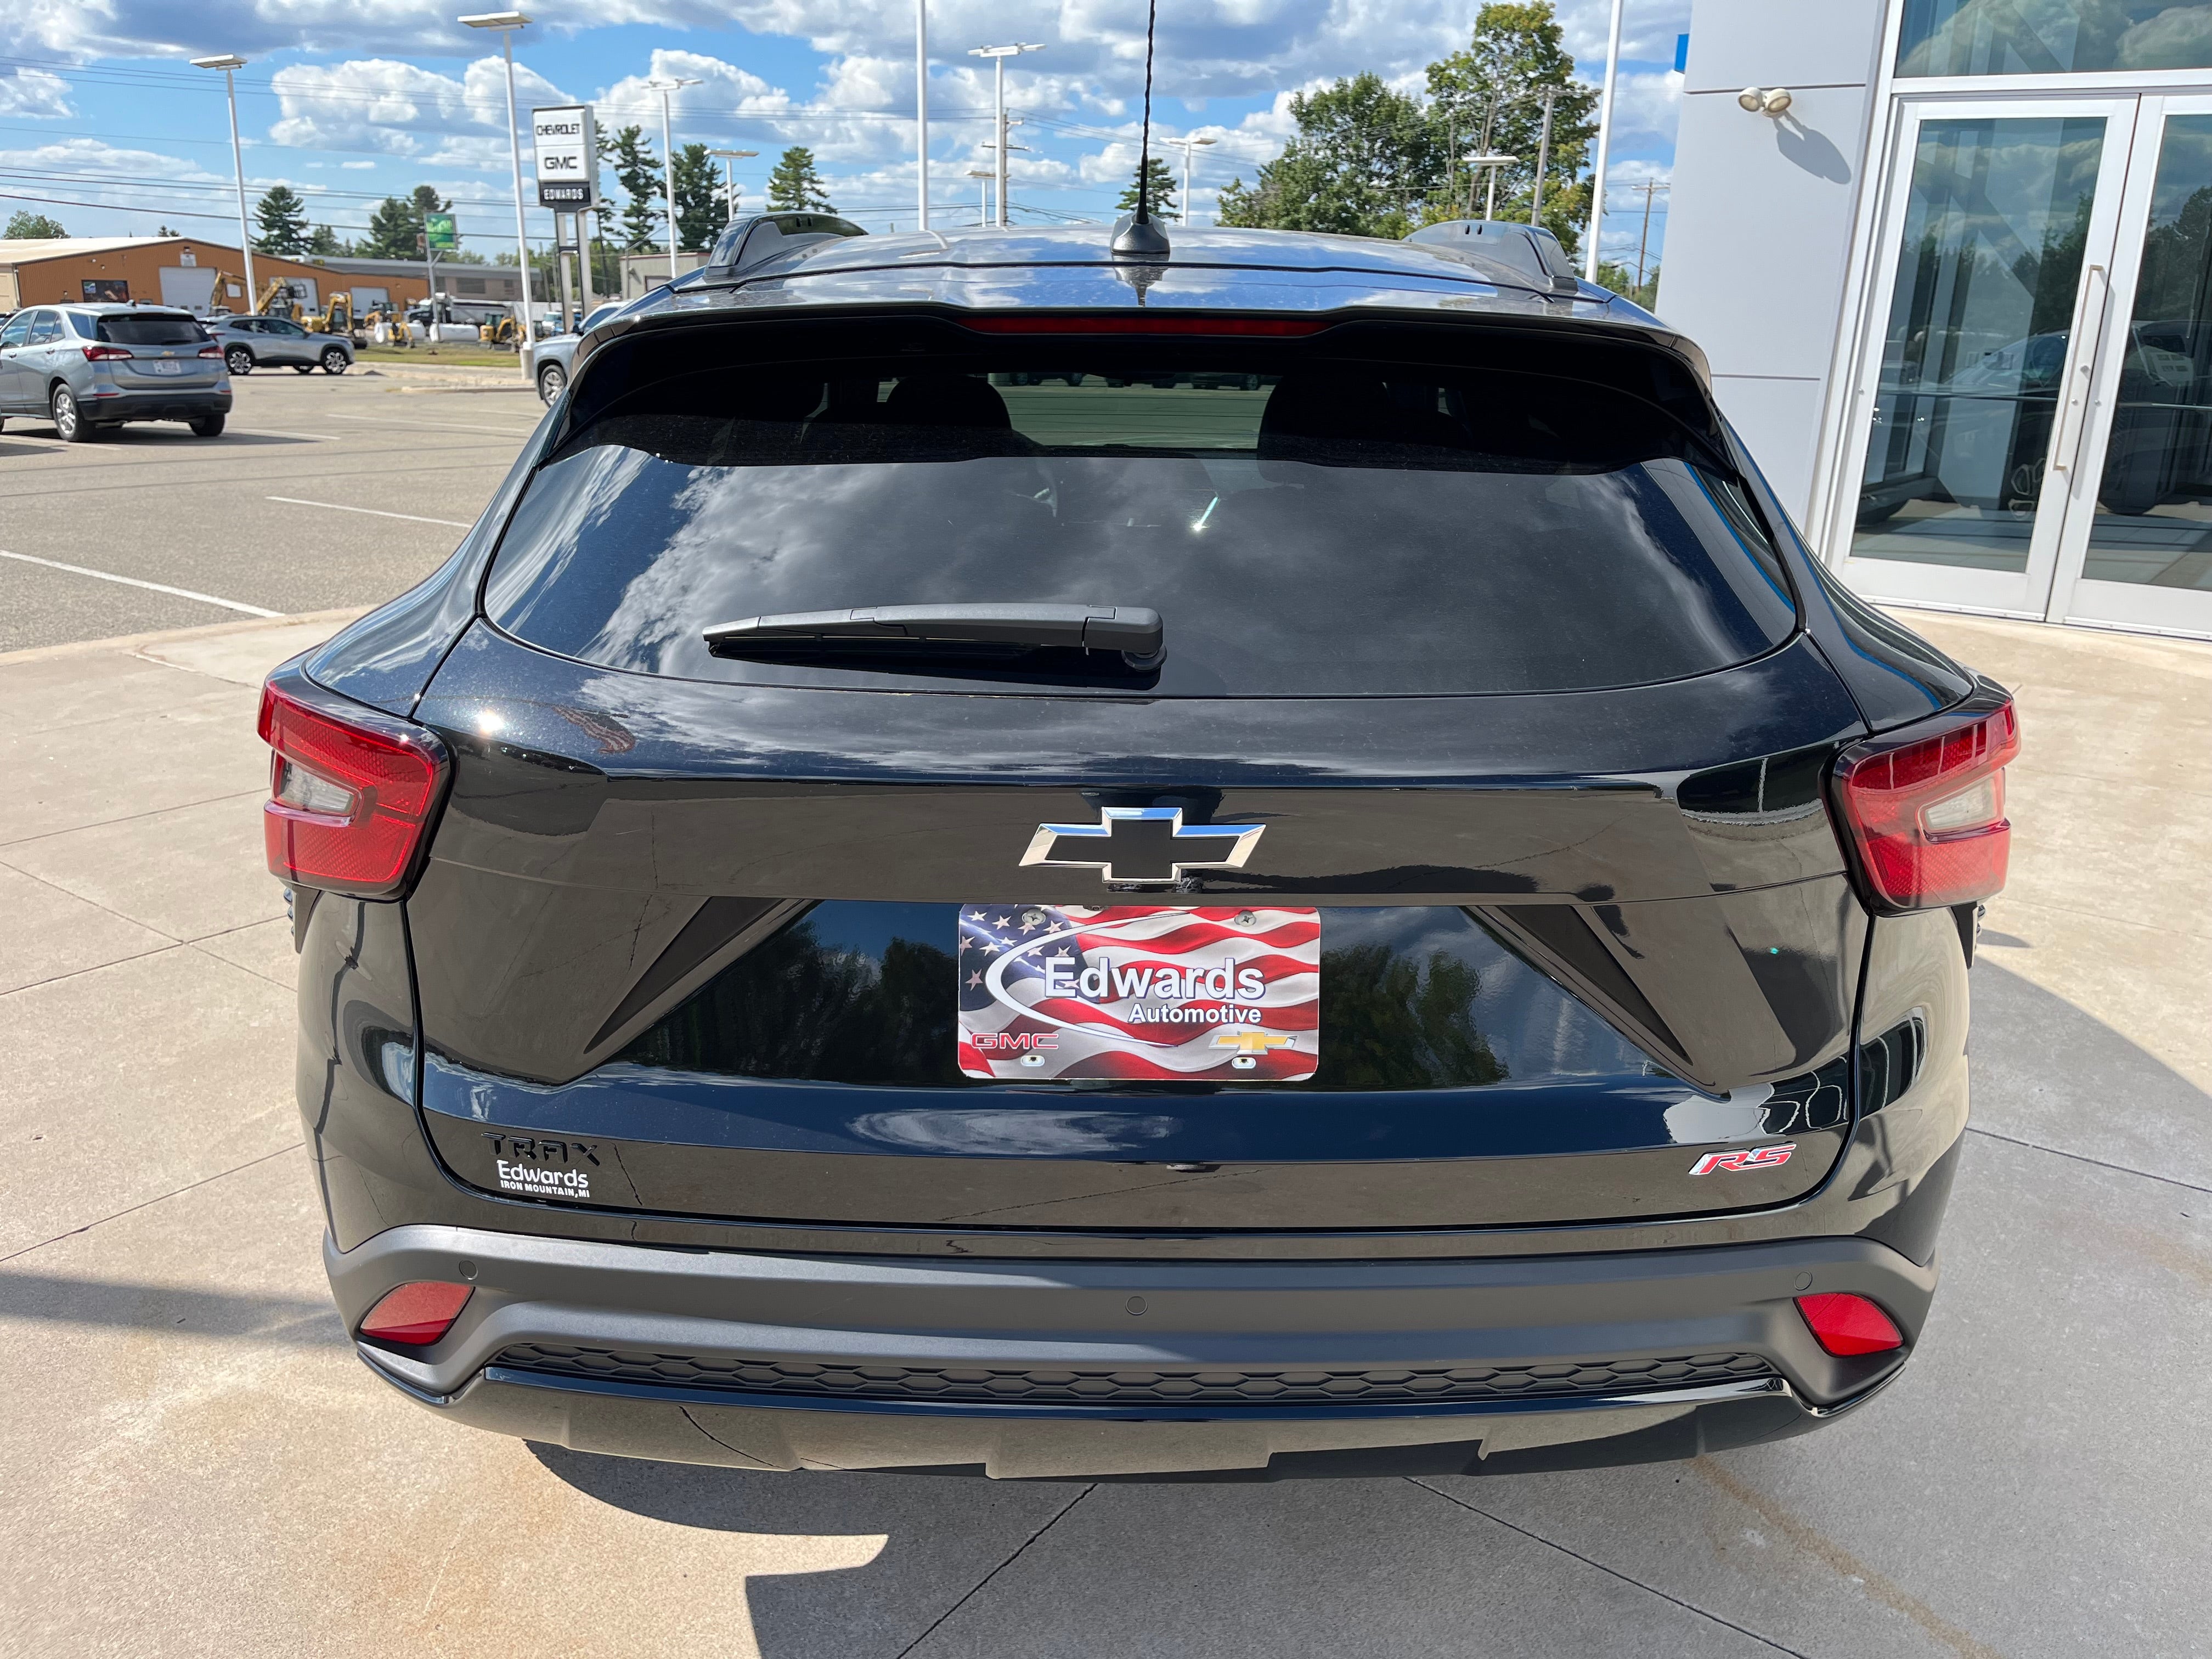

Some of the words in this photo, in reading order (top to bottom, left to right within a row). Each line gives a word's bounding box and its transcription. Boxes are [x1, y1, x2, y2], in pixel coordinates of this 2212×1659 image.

[536, 123, 580, 136] CHEVROLET
[544, 156, 577, 170] GMC
[543, 188, 584, 200] EDWARDS
[1043, 956, 1266, 1000] Edwards
[1127, 1002, 1262, 1024] Automotive
[970, 1032, 1059, 1050] GMC
[481, 1132, 600, 1166] TRAX
[1688, 1141, 1797, 1175] RS
[496, 1159, 589, 1188] Edwards
[500, 1180, 523, 1191] IRON
